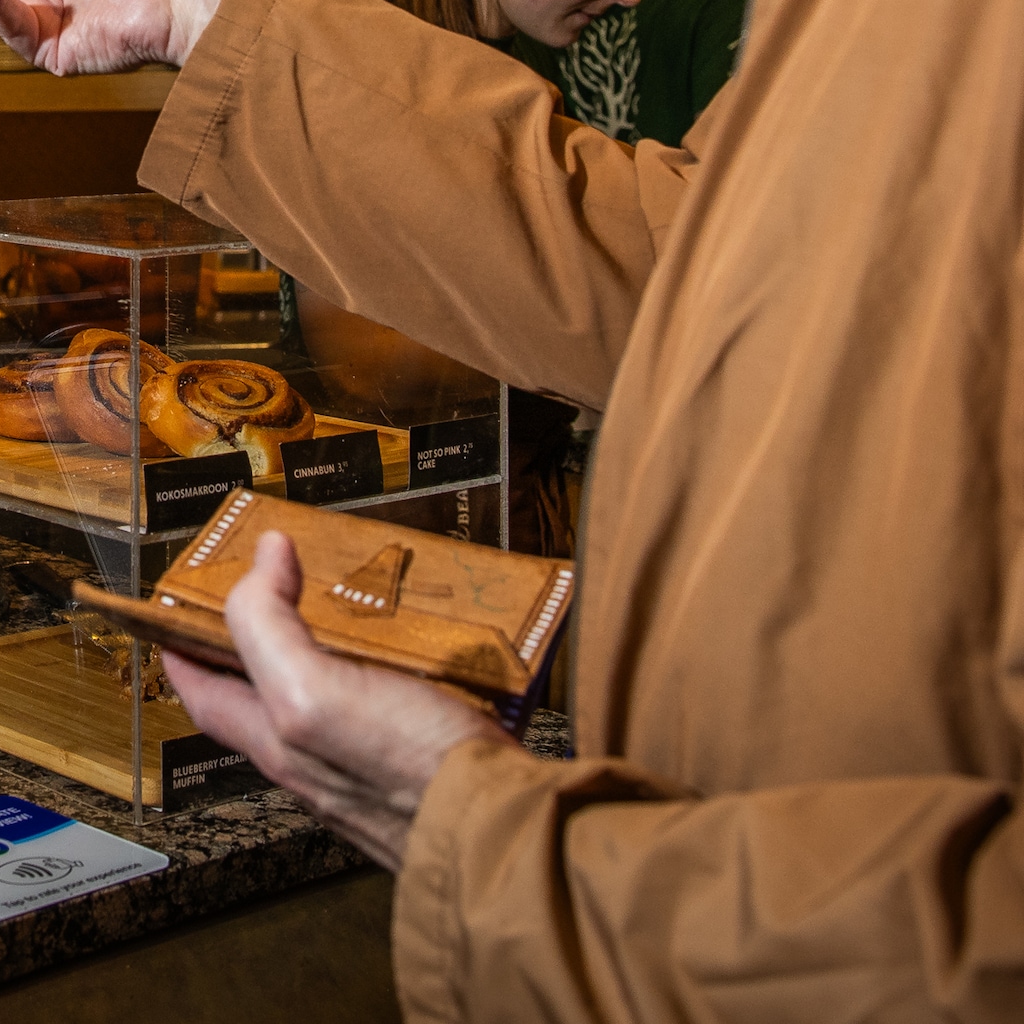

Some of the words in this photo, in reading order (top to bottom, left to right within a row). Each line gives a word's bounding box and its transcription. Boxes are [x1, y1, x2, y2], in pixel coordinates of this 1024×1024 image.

[417, 450, 434, 461] NOT
[433, 448, 444, 458] SO
[444, 444, 462, 456] PINK
[294, 464, 336, 479] CINNABUN
[417, 459, 436, 471] CAKE
[156, 482, 229, 503] KOKOSMAKROON
[172, 759, 219, 778] BLUEBERRY
[172, 774, 205, 789] MUFFIN
